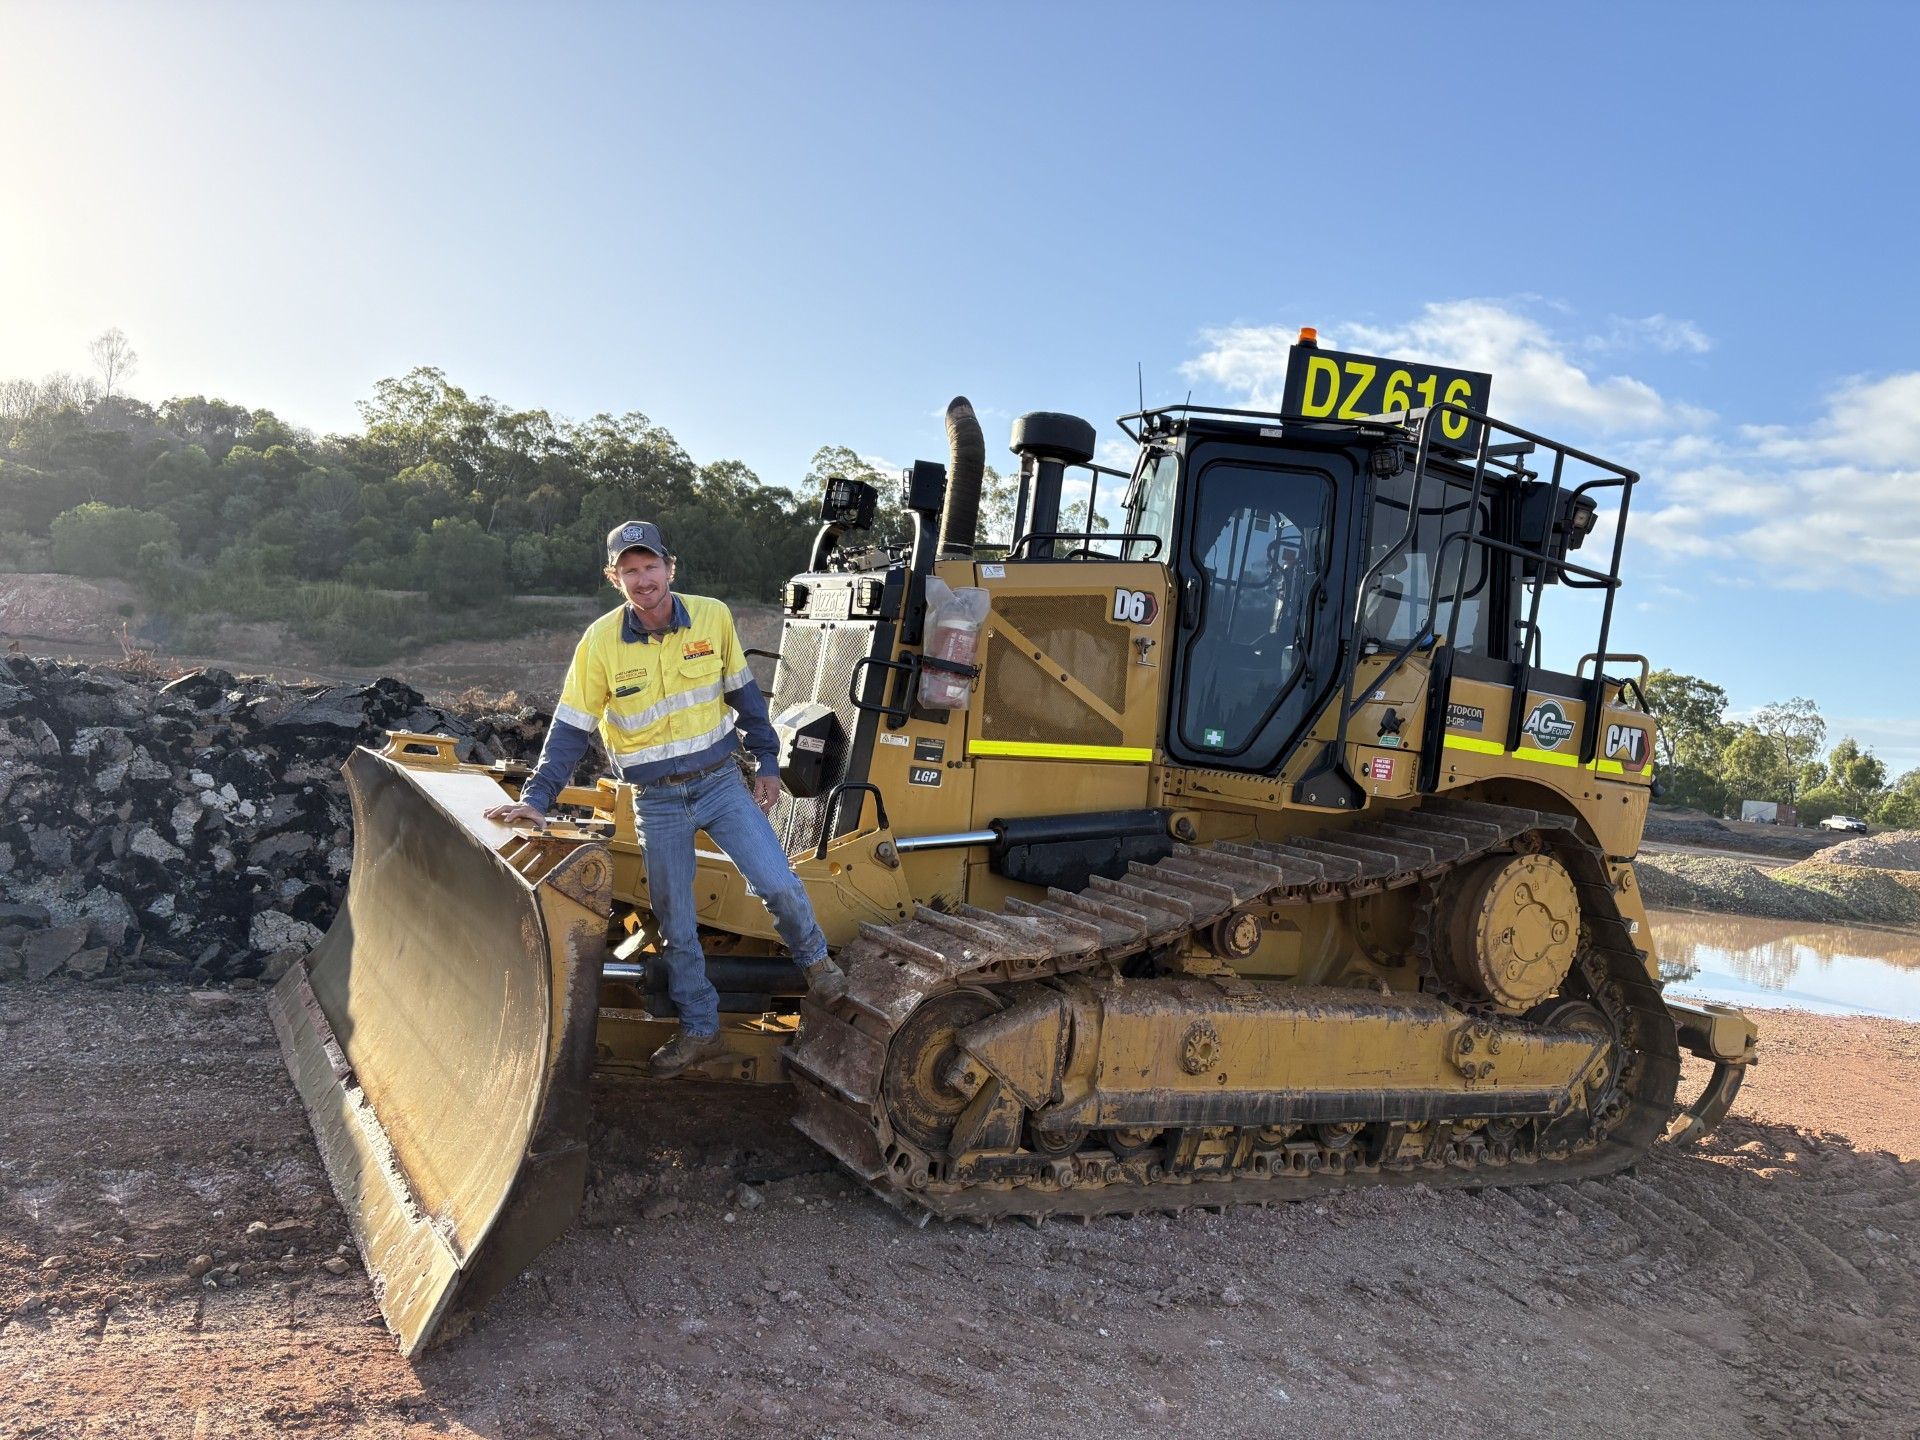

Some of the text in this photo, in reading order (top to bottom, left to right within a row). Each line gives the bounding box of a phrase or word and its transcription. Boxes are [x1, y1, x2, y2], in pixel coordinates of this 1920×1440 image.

[1301, 355, 1472, 440] DZ 616
[1113, 588, 1145, 622] D6
[1446, 715, 1465, 727] D-GPS
[1453, 705, 1482, 719] TOPCON
[1524, 710, 1572, 733] AG
[1551, 727, 1571, 736] EQUIP
[1605, 724, 1642, 762] CAT
[914, 770, 938, 783] LGP
